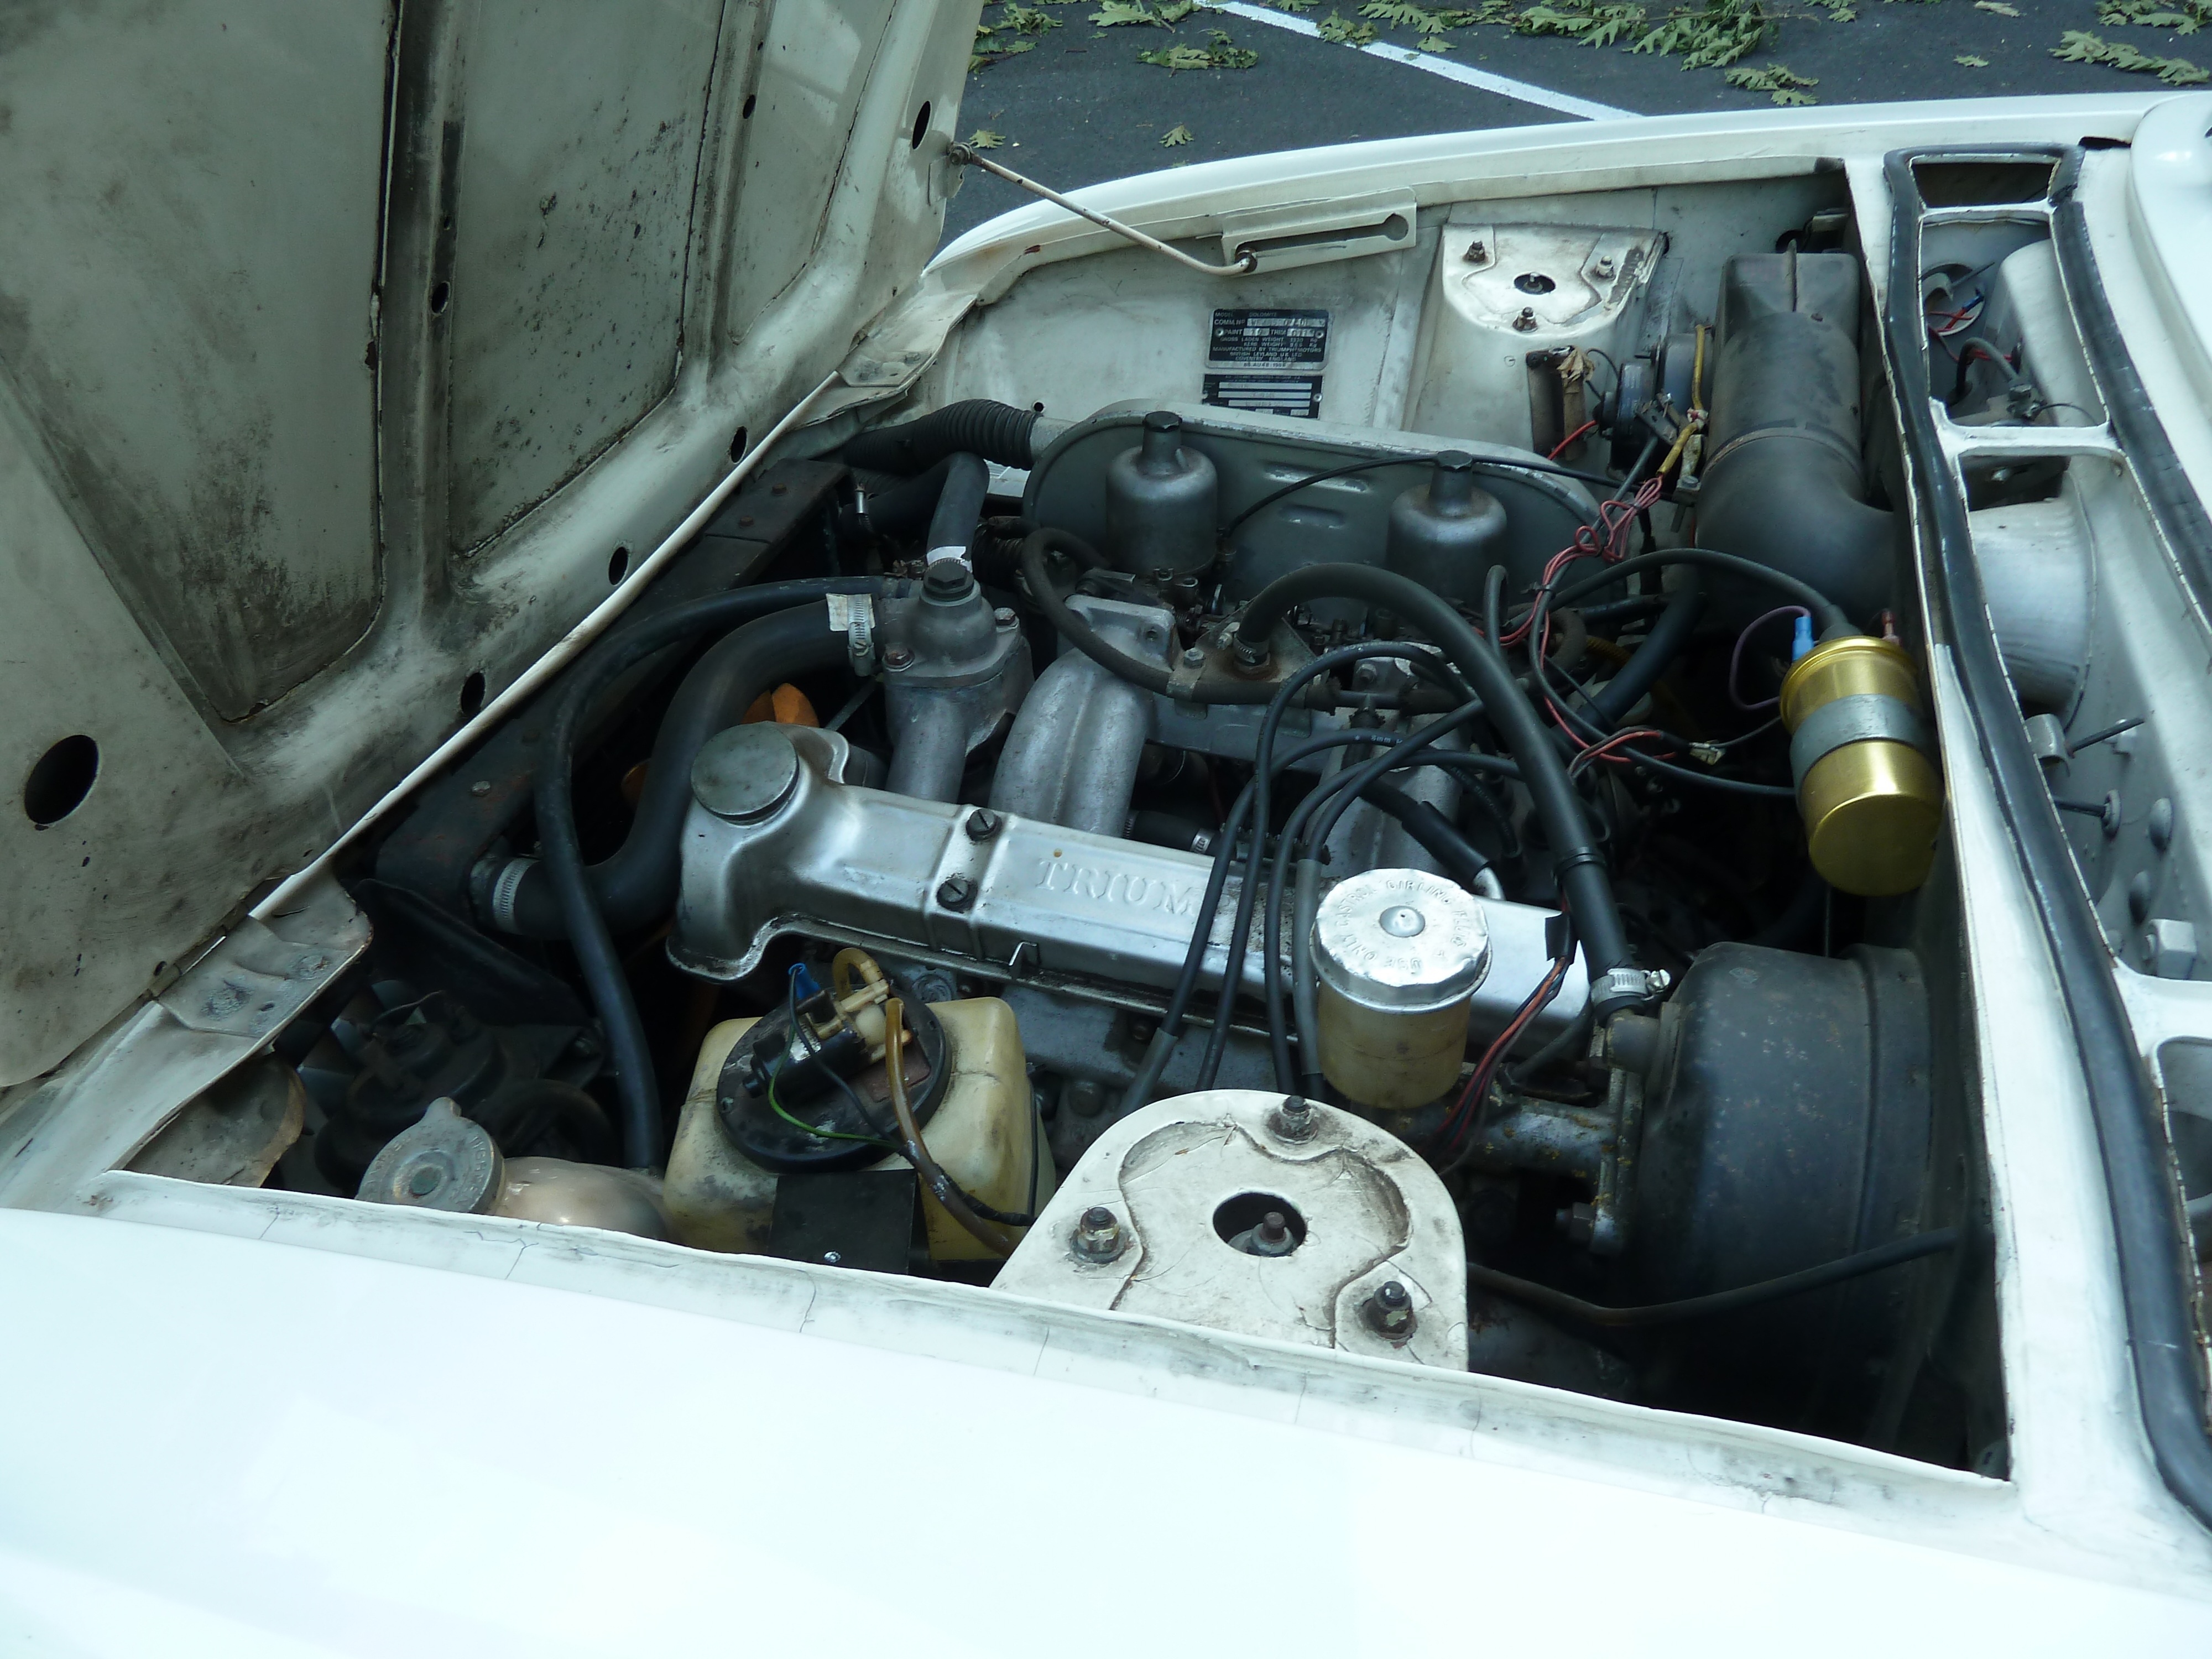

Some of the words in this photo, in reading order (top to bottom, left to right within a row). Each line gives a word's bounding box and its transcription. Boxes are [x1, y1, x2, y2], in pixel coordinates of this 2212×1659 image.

[1035, 857, 1202, 916] TRIUM
[1386, 879, 1452, 905] GIRLING
[1335, 885, 1378, 927] CASTROL
[1340, 933, 1378, 961] ONLY
[1384, 957, 1423, 974] USE
